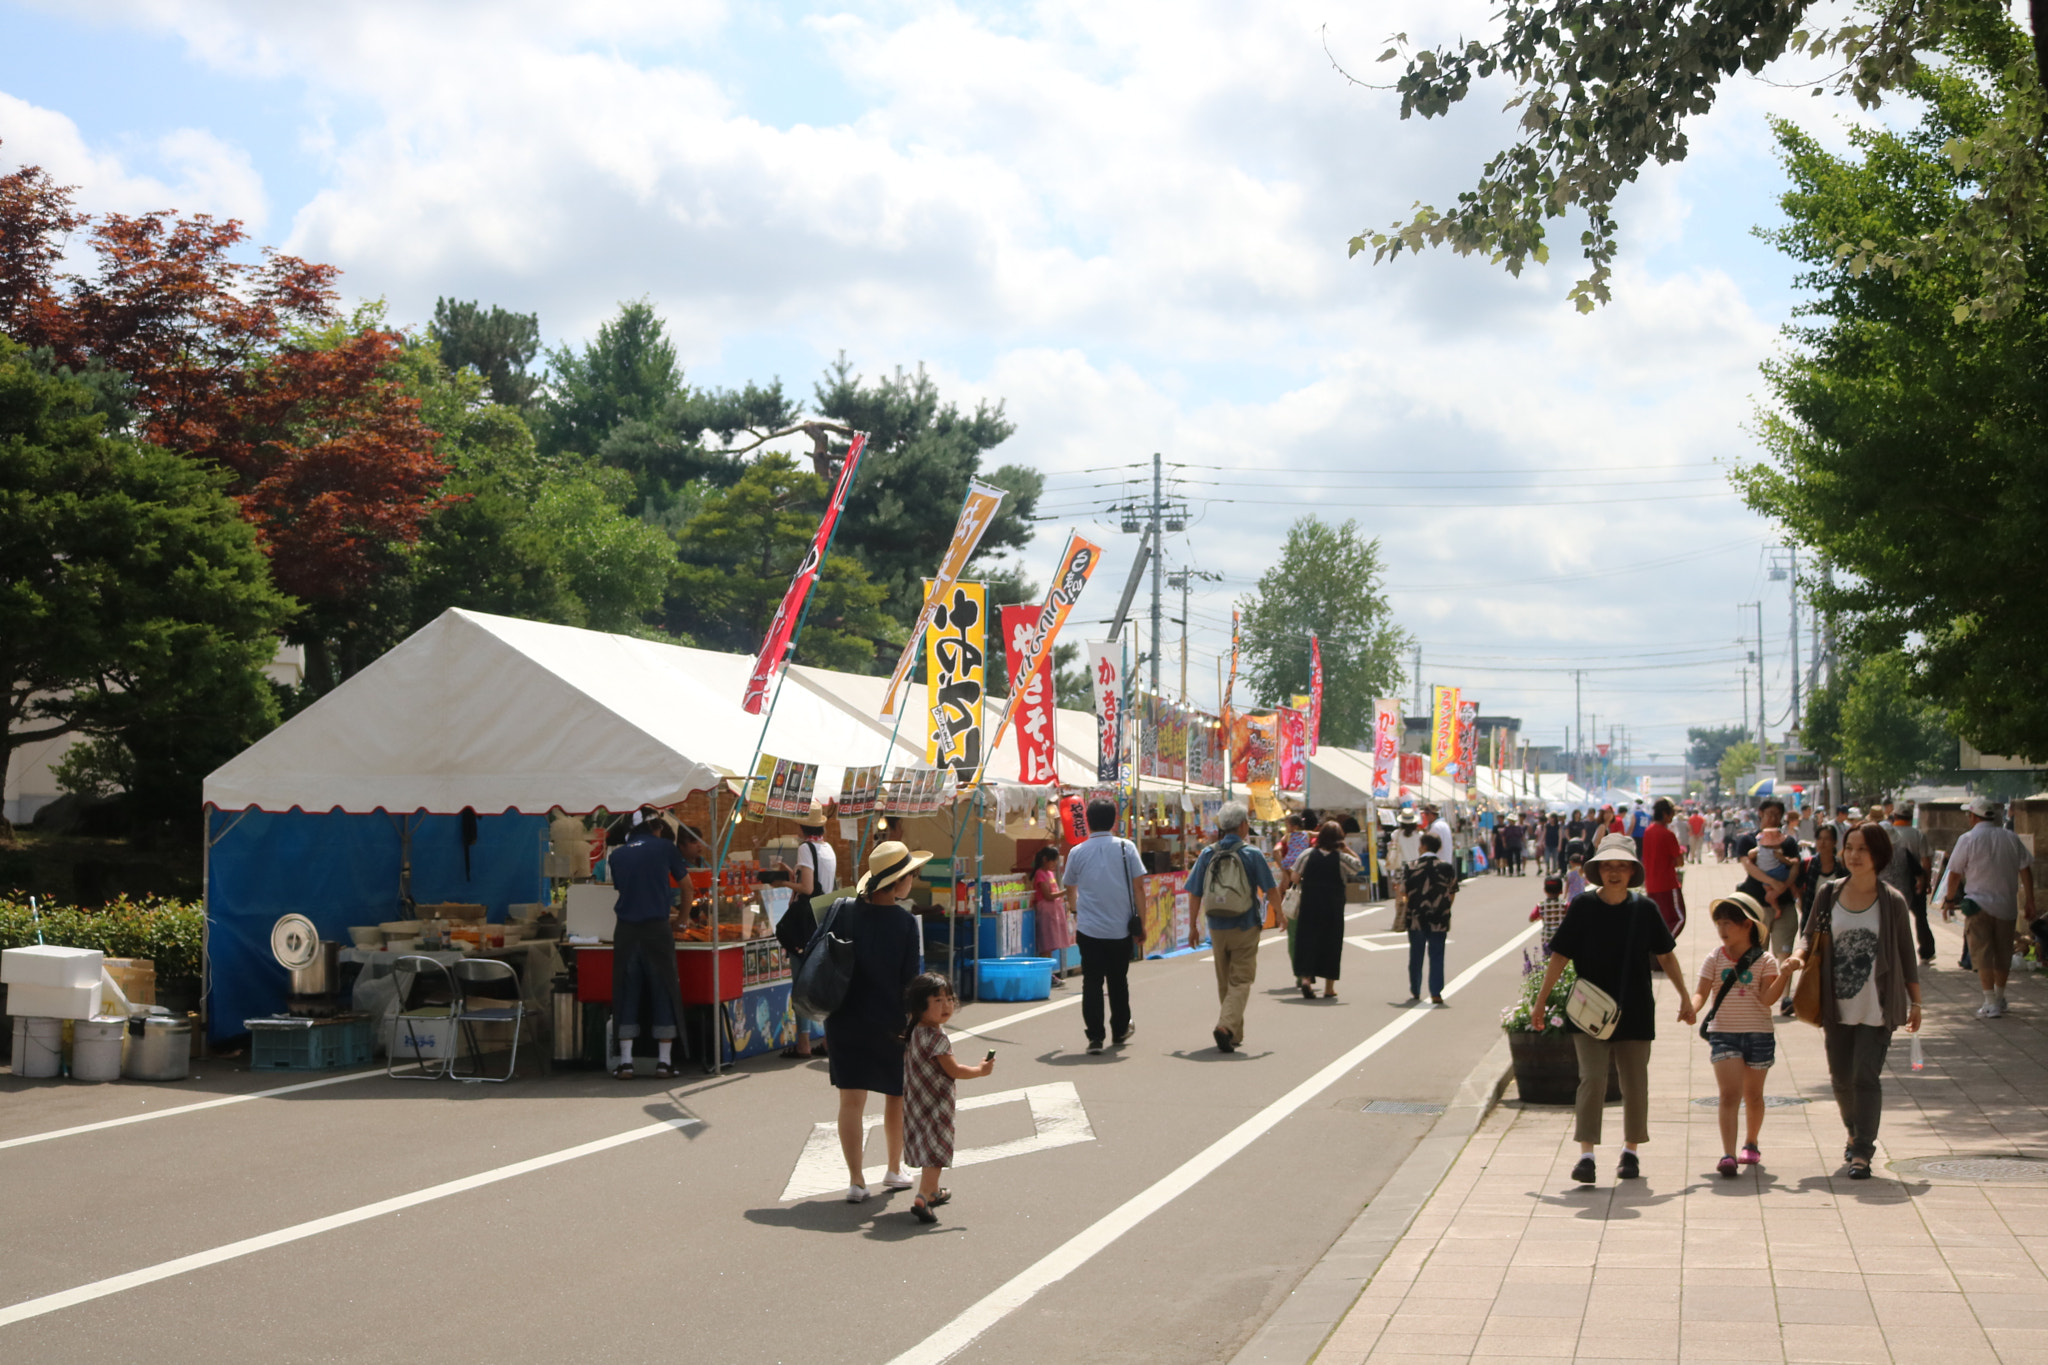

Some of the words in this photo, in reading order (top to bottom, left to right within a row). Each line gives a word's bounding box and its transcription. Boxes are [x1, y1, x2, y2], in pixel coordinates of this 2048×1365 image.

[1098, 656, 1116, 759] かき氷
[1437, 689, 1453, 761] フランクフルト
[1372, 711, 1397, 788] かき氷
[1070, 802, 1087, 838] やきそば
